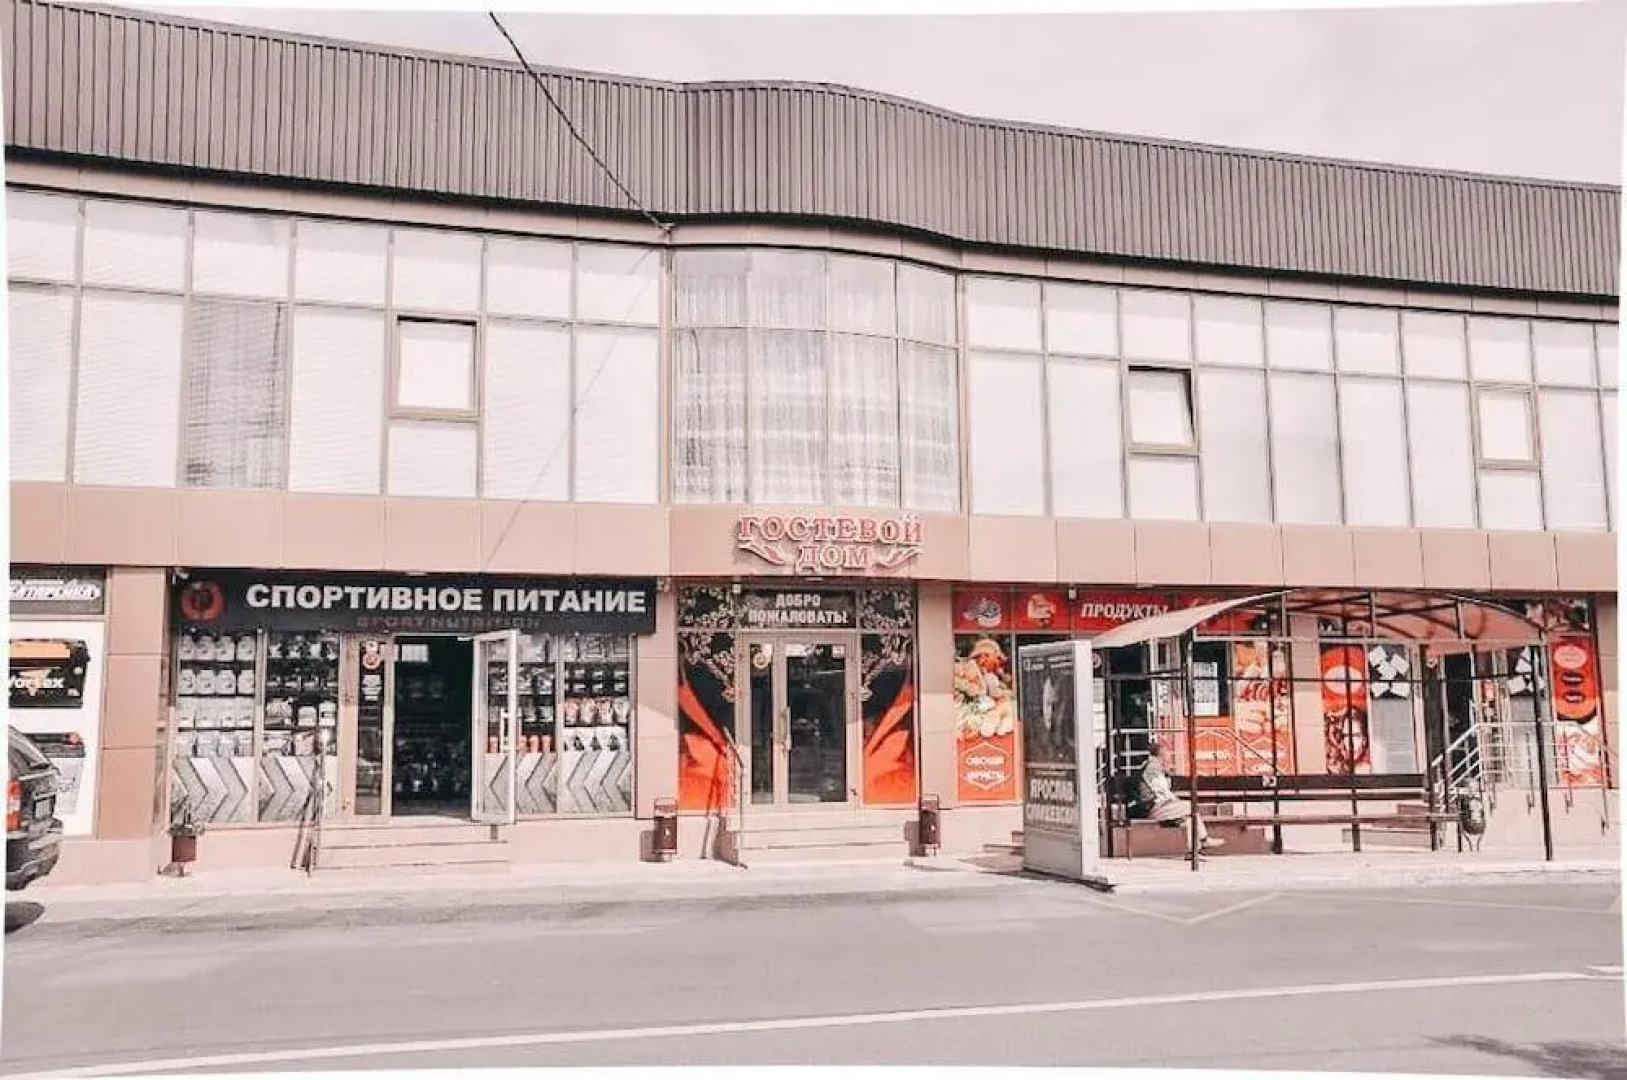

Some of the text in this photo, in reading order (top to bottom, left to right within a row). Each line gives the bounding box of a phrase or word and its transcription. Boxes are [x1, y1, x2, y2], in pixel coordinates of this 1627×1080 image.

[738, 515, 924, 543] ГОСТЕВОЙ
[797, 545, 874, 572] ДОМ
[246, 584, 646, 614] СПОРТИВНОЕ ПИТАНИЕ
[775, 594, 821, 608] ДОБРО
